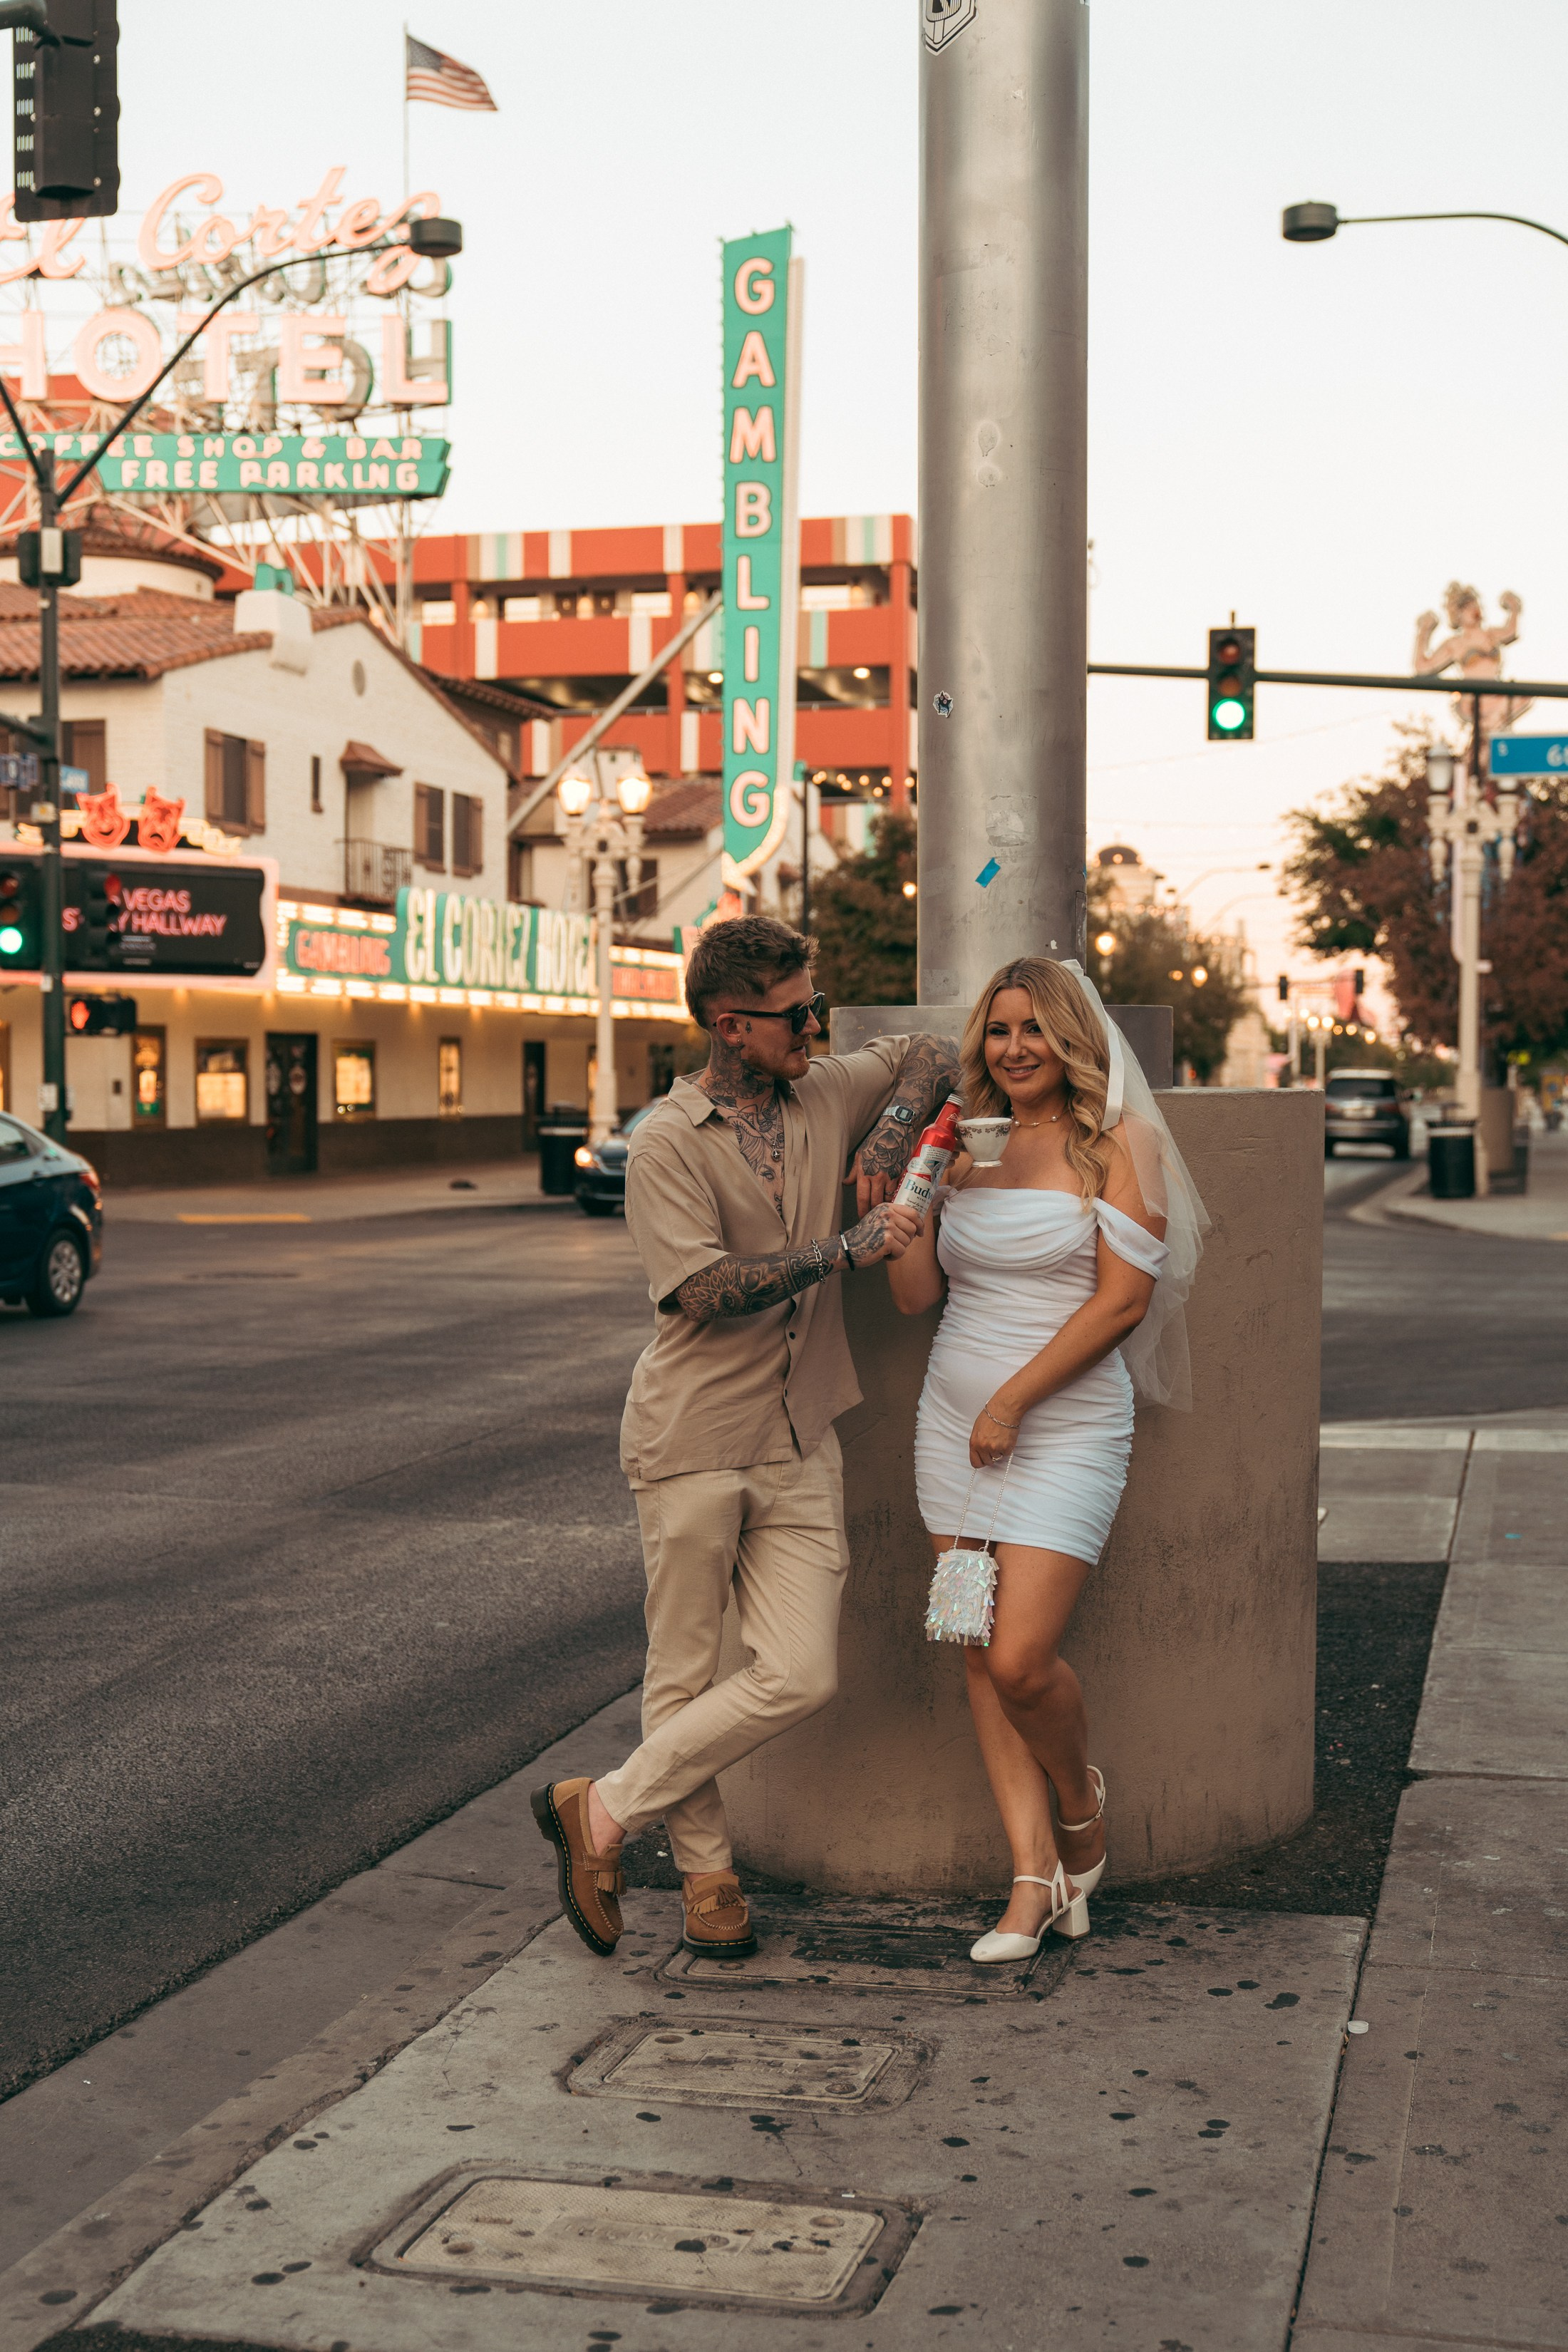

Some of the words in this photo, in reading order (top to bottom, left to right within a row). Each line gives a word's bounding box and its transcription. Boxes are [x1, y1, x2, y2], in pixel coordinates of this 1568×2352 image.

[0, 306, 450, 404] HOTEL
[177, 435, 283, 460] SHOP
[301, 436, 326, 459] &
[346, 437, 423, 460] BAR
[121, 460, 219, 488] FREE
[239, 460, 419, 491] PARKING
[728, 257, 778, 827] GAMBLING
[122, 888, 192, 913] VEGAS
[130, 911, 228, 937] HALLWAY
[405, 887, 440, 983] EL
